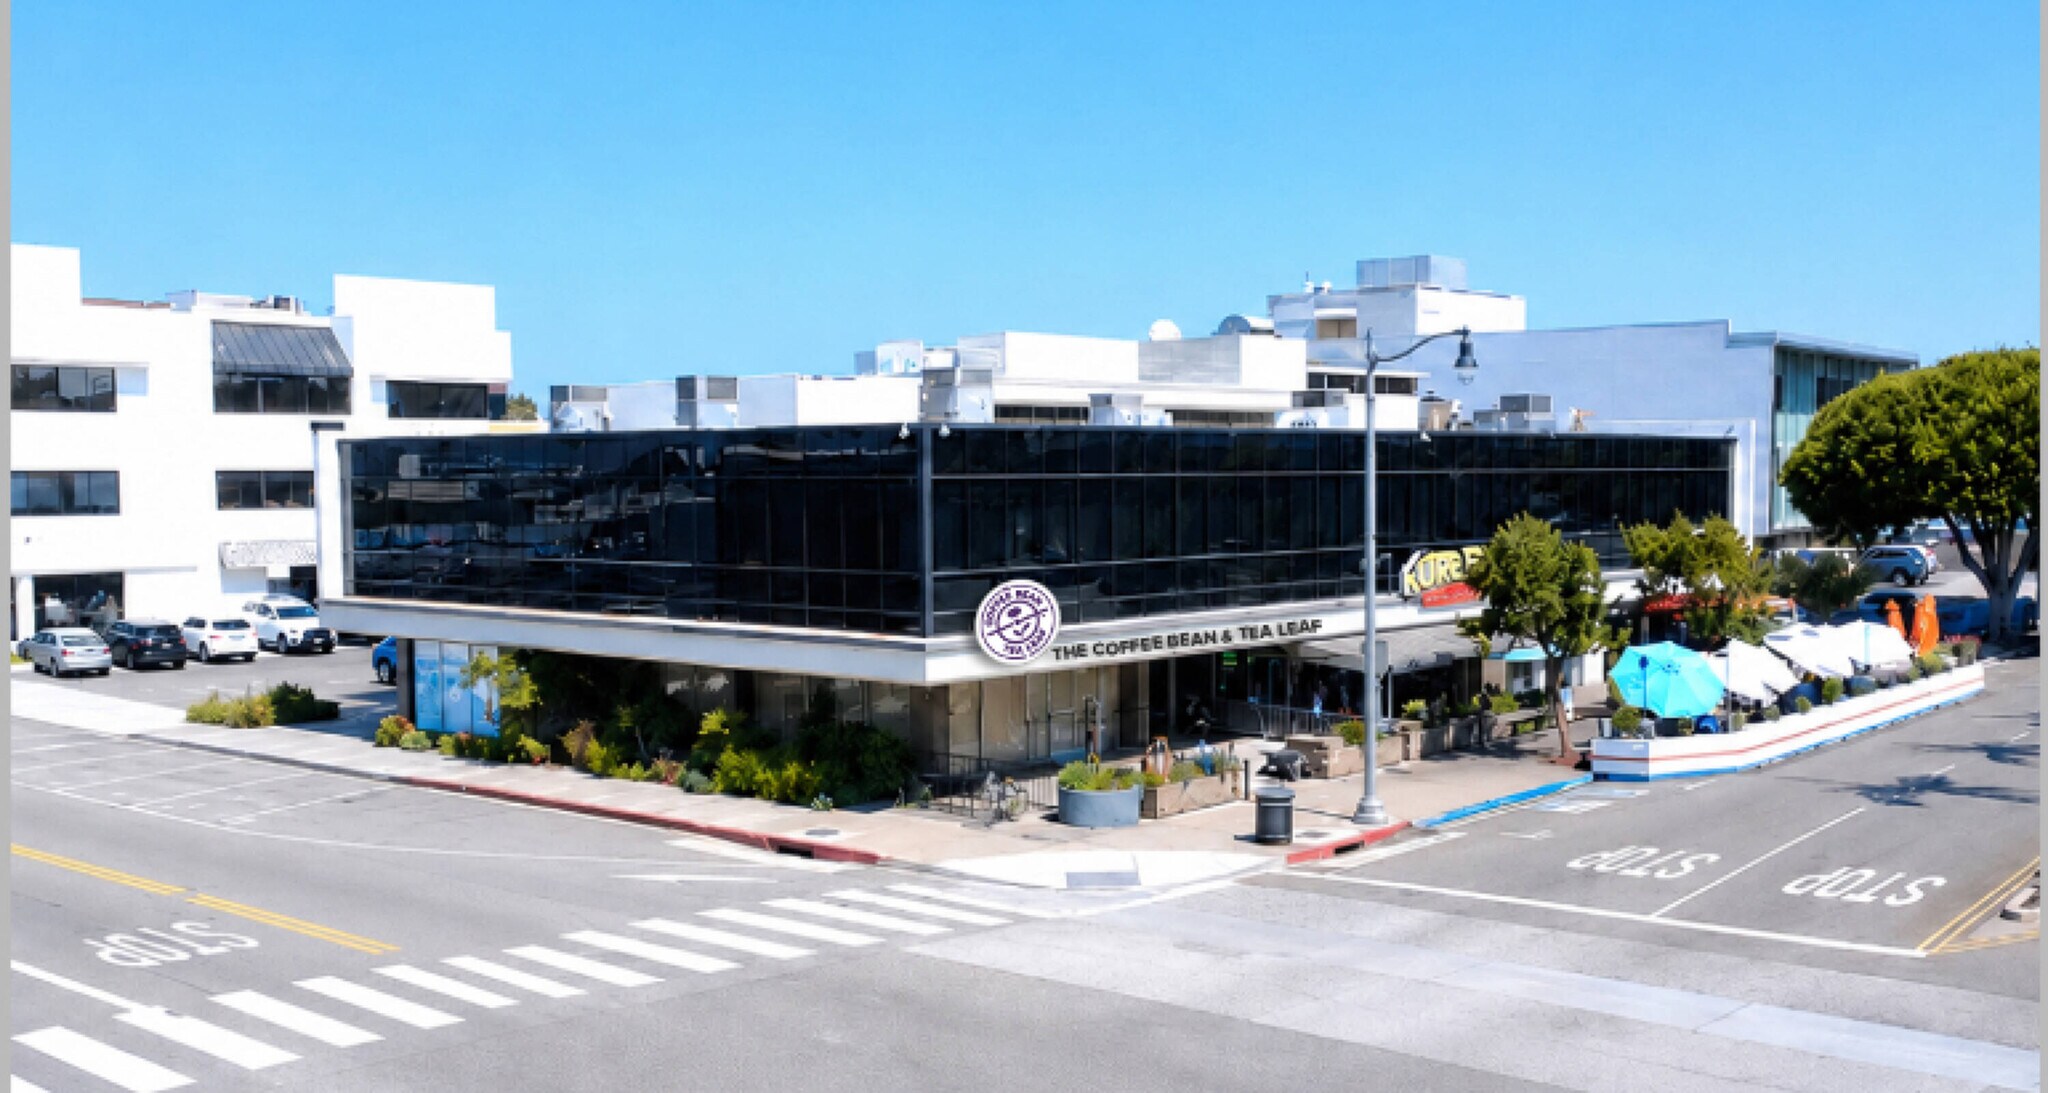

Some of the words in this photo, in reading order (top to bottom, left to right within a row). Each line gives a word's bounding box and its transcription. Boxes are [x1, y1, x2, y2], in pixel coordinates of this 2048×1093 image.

[1052, 643, 1088, 660] THE
[1093, 635, 1162, 657] COFFEE
[1167, 630, 1216, 648] BEAN
[1220, 629, 1232, 644] &
[1238, 624, 1273, 639] TEA
[1277, 619, 1322, 637] LEAF
[1566, 845, 1721, 879] STOP
[1781, 866, 1947, 907] STOP
[82, 921, 259, 968] STOP
